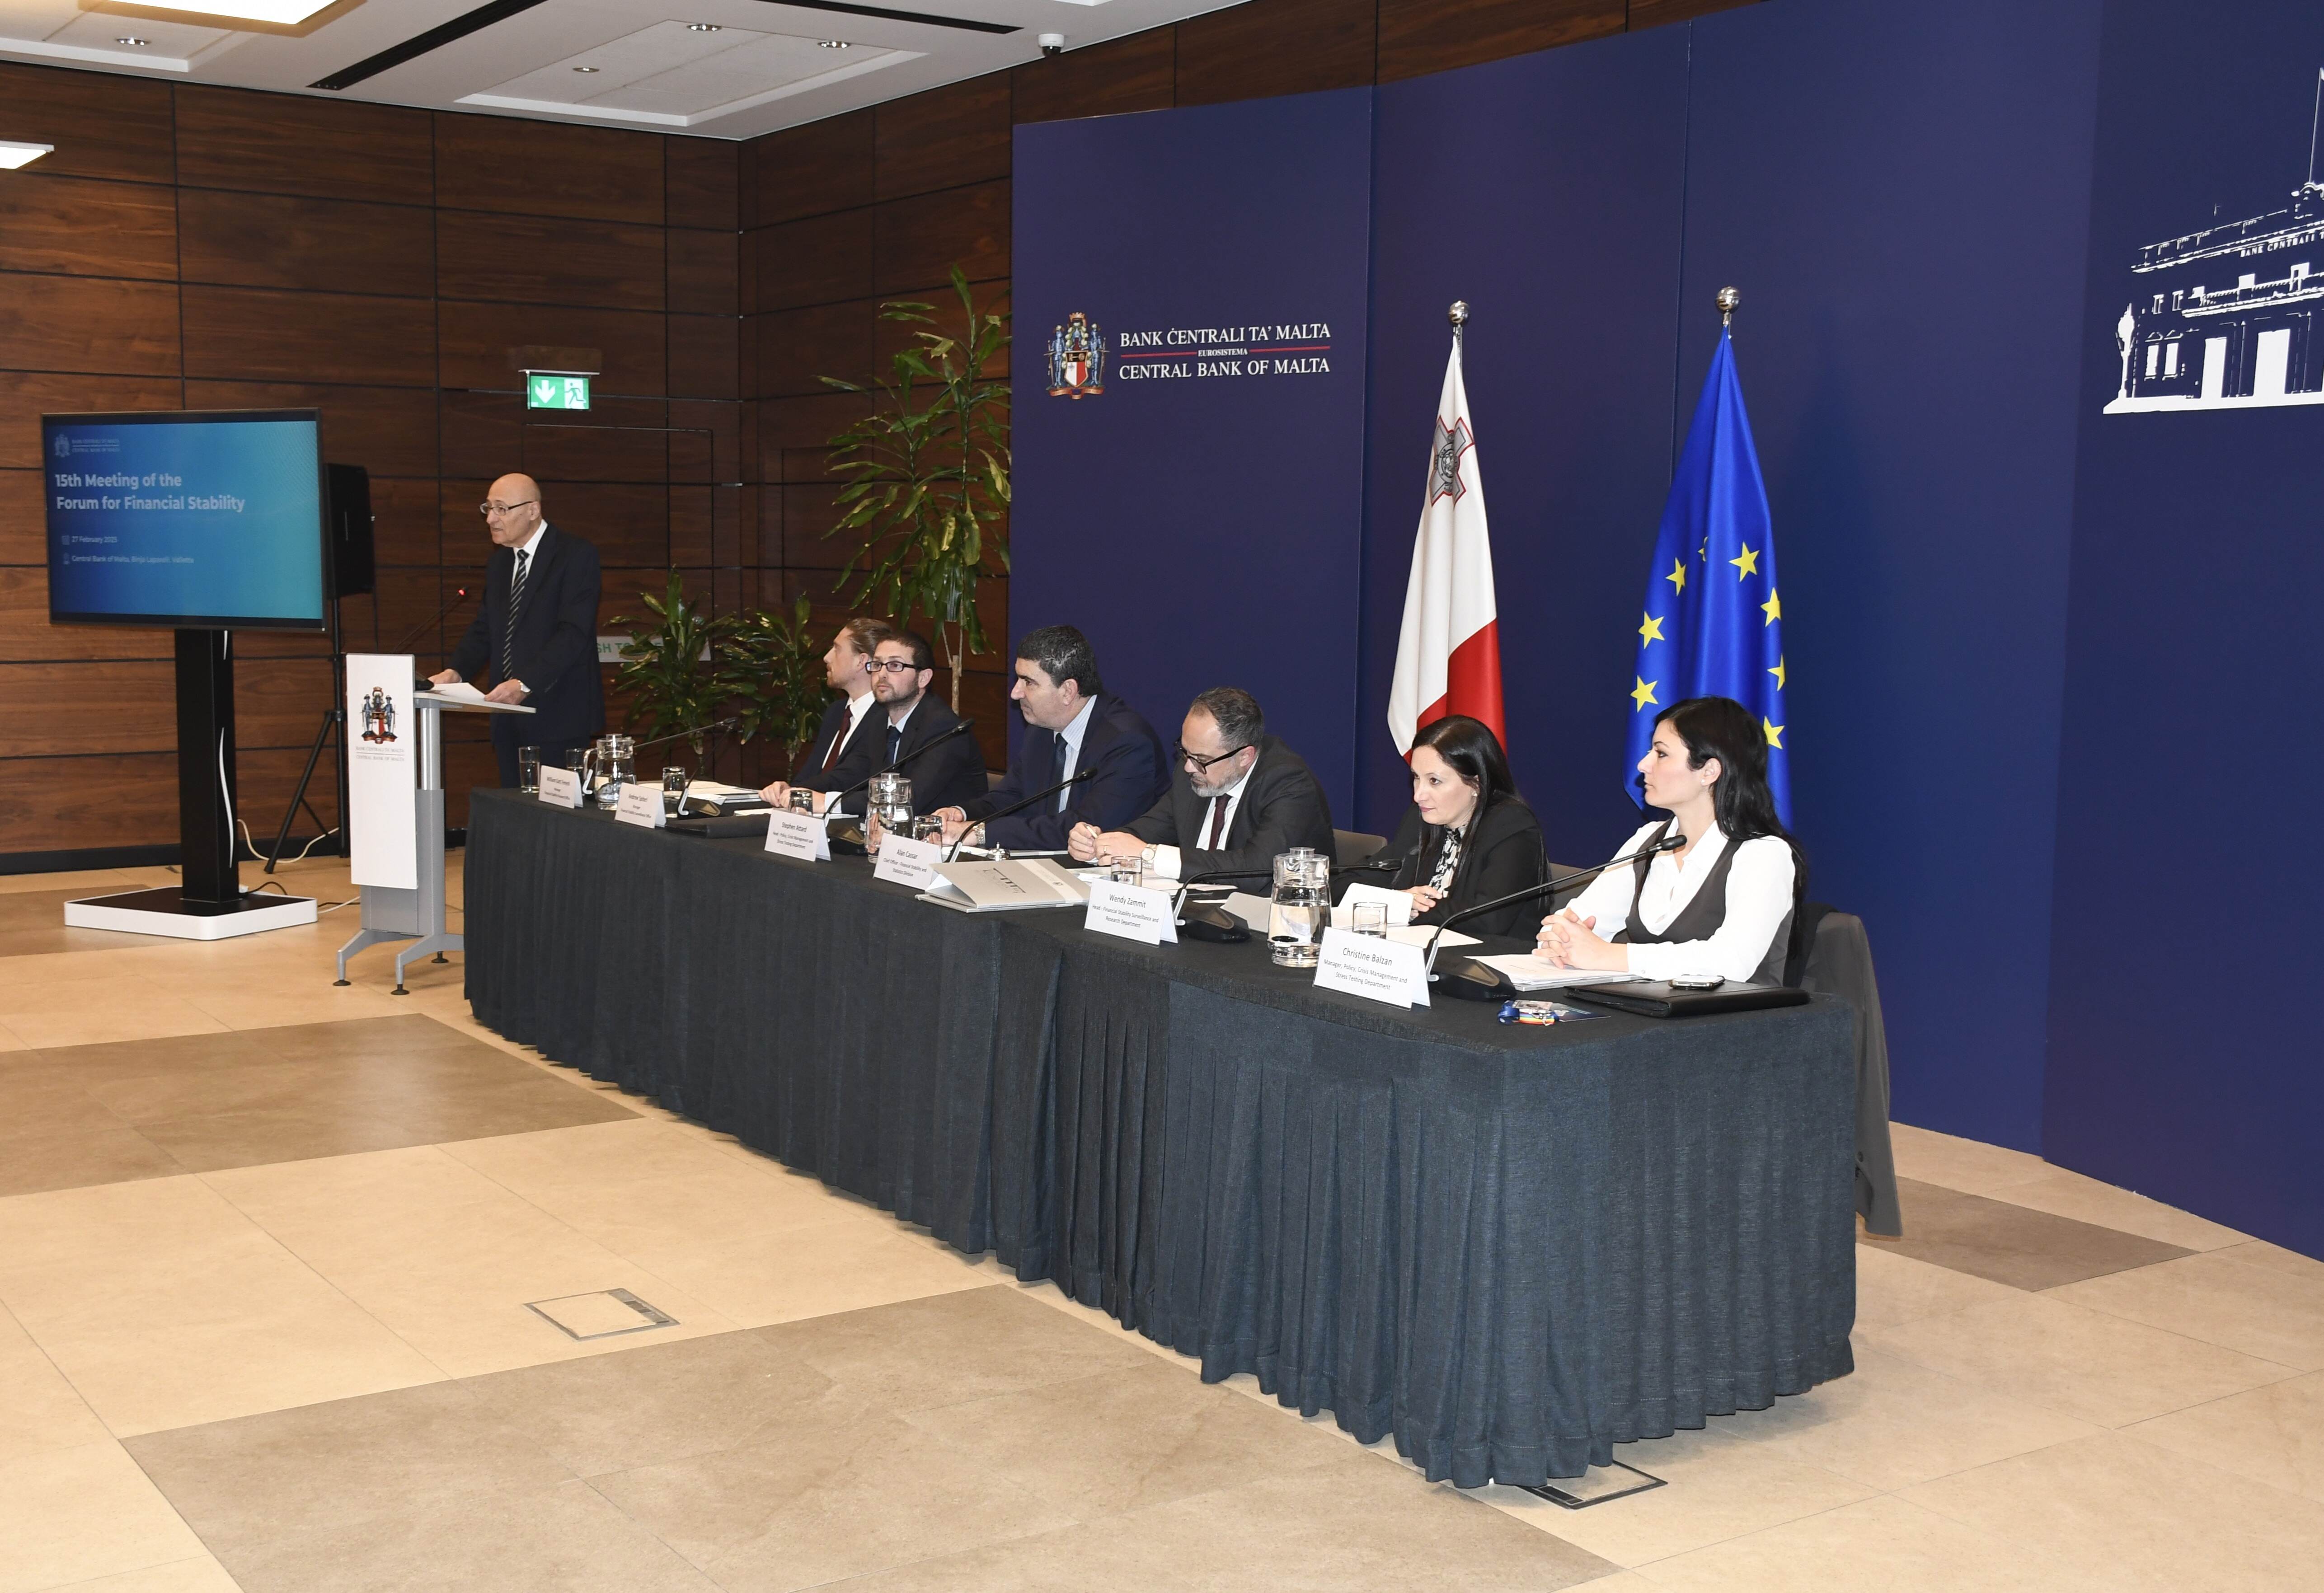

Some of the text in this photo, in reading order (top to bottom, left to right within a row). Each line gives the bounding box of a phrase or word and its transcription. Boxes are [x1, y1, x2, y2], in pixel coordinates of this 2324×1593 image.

[1120, 332, 1163, 347] BANK
[1167, 328, 1244, 345] ĊENTRALI
[1275, 323, 1331, 339] MALTA
[1198, 348, 1248, 357] EUROSISTEMA
[1119, 358, 1330, 379] CENTRAL BANK OF MALTA
[55, 473, 182, 490] 15th Meeting of the
[57, 494, 245, 513] Forum for Financial Stability
[597, 643, 611, 653] SH
[1109, 894, 1146, 908] Wendy Zammit
[1121, 919, 1141, 928] Department
[1131, 913, 1151, 921] Surveillance
[1343, 947, 1392, 966] Christine Balzan
[1324, 959, 1342, 969] Manager,
[1343, 964, 1356, 972] Policy,
[1370, 970, 1398, 981] Management
[1349, 975, 1363, 984] Testing
[1364, 979, 1390, 990] Department
